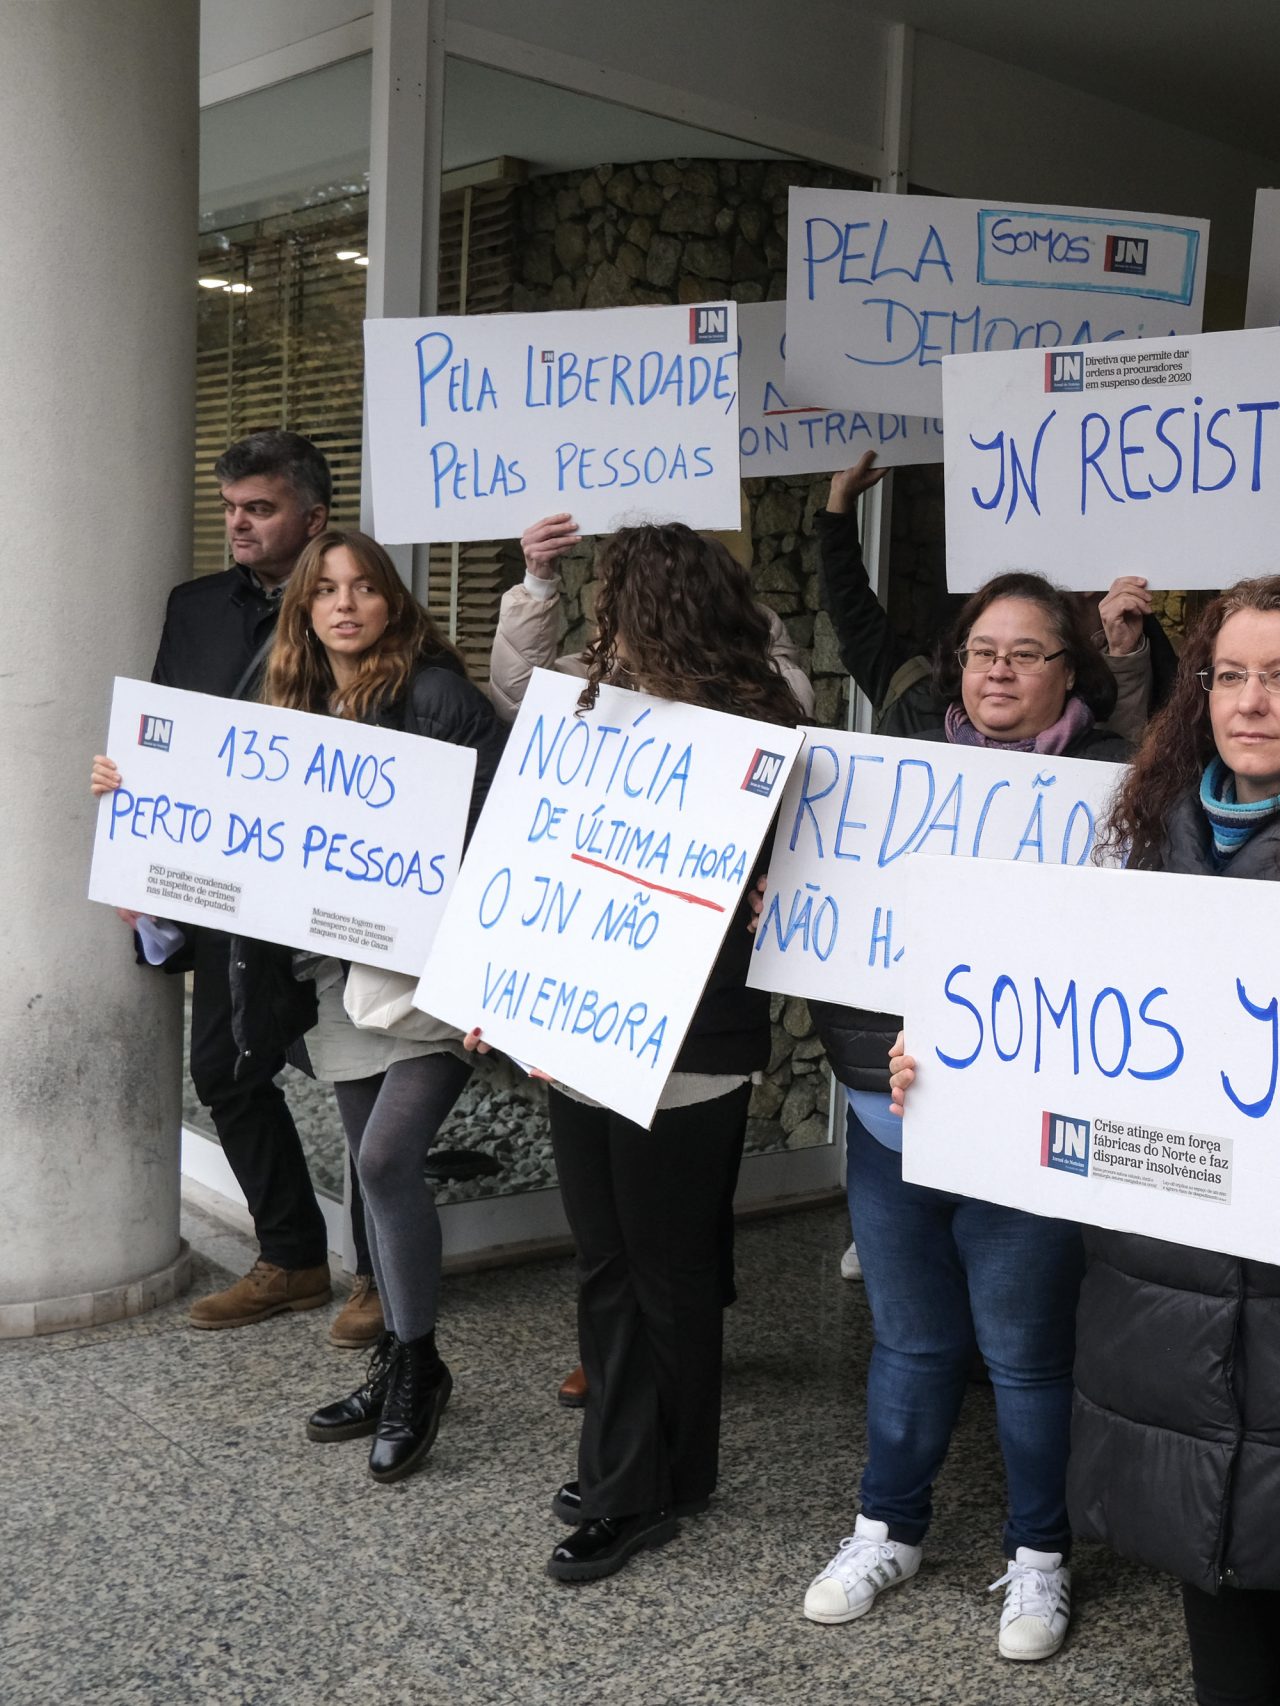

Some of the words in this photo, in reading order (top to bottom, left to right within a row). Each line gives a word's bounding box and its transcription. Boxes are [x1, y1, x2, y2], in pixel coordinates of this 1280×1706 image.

[990, 217, 1091, 264] SOMOS
[1115, 240, 1144, 264] JN
[803, 217, 954, 300] PELA
[697, 310, 724, 333] JN
[1054, 356, 1080, 381] JN
[1086, 355, 1118, 366] Diretiva
[1120, 354, 1136, 364] que
[1138, 351, 1172, 364] permite
[1174, 350, 1190, 359] dar
[1086, 367, 1114, 378] ordens
[1124, 363, 1182, 377] procuradores
[415, 331, 499, 428] PELA
[1100, 378, 1140, 390] suspenso
[1141, 376, 1166, 385] desde
[1168, 372, 1192, 382] 2020
[430, 441, 527, 508] PELAS
[555, 442, 714, 492] PESSOAS
[969, 408, 1057, 525] JN
[144, 717, 172, 744] JN
[217, 724, 291, 783] 135
[303, 742, 397, 810] ANOS
[518, 706, 694, 812] NOTÍCIA
[752, 755, 781, 784] JN
[108, 787, 212, 846] PERTO
[221, 812, 286, 863] DAS
[302, 824, 447, 896] PESSOAS
[527, 797, 569, 843] DE
[574, 803, 672, 876] ÚLTIMA
[677, 838, 748, 886] HORA
[148, 876, 158, 884] ou
[160, 879, 196, 892] suspeitos
[196, 886, 206, 896] de
[208, 889, 235, 902] crimes
[150, 864, 166, 876] PSD
[194, 876, 242, 894] condenados
[146, 886, 160, 894] nas
[162, 888, 182, 900] listas
[183, 893, 193, 902] de
[194, 896, 236, 912] deputados
[312, 908, 350, 922] Moradores
[478, 866, 512, 930] O
[521, 875, 583, 936] JN
[590, 890, 661, 951] NÃO
[310, 927, 336, 938] ataques
[348, 935, 359, 944] Sul
[371, 940, 388, 950] Gaza
[311, 918, 347, 932] desespero
[348, 926, 363, 936] com
[754, 881, 840, 963] NÃO
[868, 905, 905, 970] H
[934, 963, 1185, 1082] SOMOS
[1052, 1120, 1086, 1160] JN
[1094, 1118, 1124, 1134] Crise
[1127, 1126, 1163, 1144] atinge
[1166, 1133, 1185, 1146] em
[1188, 1134, 1221, 1154] força
[1094, 1134, 1141, 1154] fábricas
[1144, 1144, 1158, 1156] do
[1162, 1146, 1196, 1164] Norte
[1200, 1155, 1206, 1164] e
[1210, 1154, 1228, 1170] faz
[1094, 1150, 1144, 1169] disparar
[1146, 1159, 1222, 1184] insolvências
